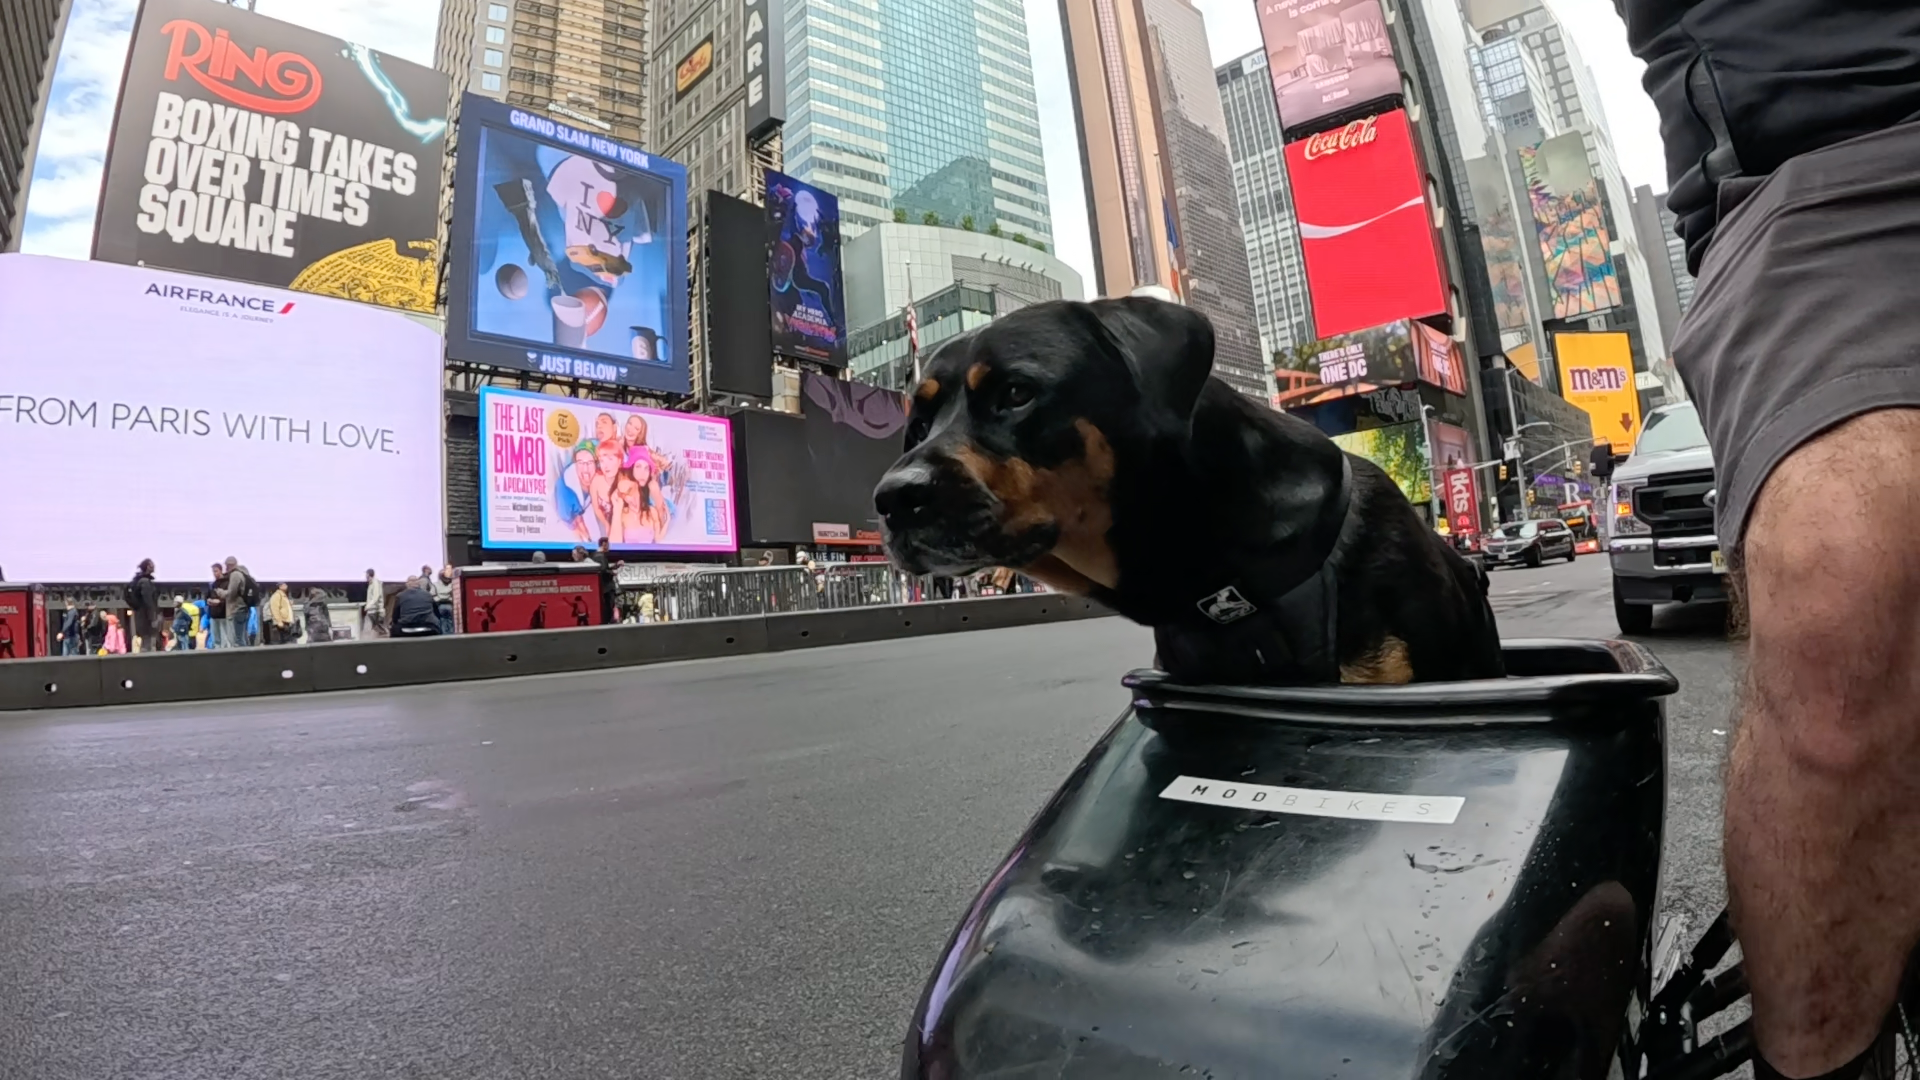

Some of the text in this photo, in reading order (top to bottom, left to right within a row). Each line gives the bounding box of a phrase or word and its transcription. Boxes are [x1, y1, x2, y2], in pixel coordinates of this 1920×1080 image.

[152, 92, 418, 196] BOXING TAKES
[510, 109, 649, 169] GRAND SLAM NEW YORK
[144, 137, 371, 227] OVER TIMES
[136, 183, 297, 258] SQUARE
[575, 206, 625, 246] NY
[145, 283, 275, 313] AIRFRANCE
[540, 354, 617, 381] JUST BELOW
[1318, 347, 1346, 362] THERE'S
[1320, 358, 1367, 385] ONE DC
[0, 395, 401, 455] FROM PARIS WITH LOVE.
[493, 402, 545, 435] THE LAST
[493, 433, 546, 476] BIMBO
[503, 476, 546, 495] APOCALYPSE
[1450, 471, 1470, 513] tkts
[830, 551, 846, 561] FIN
